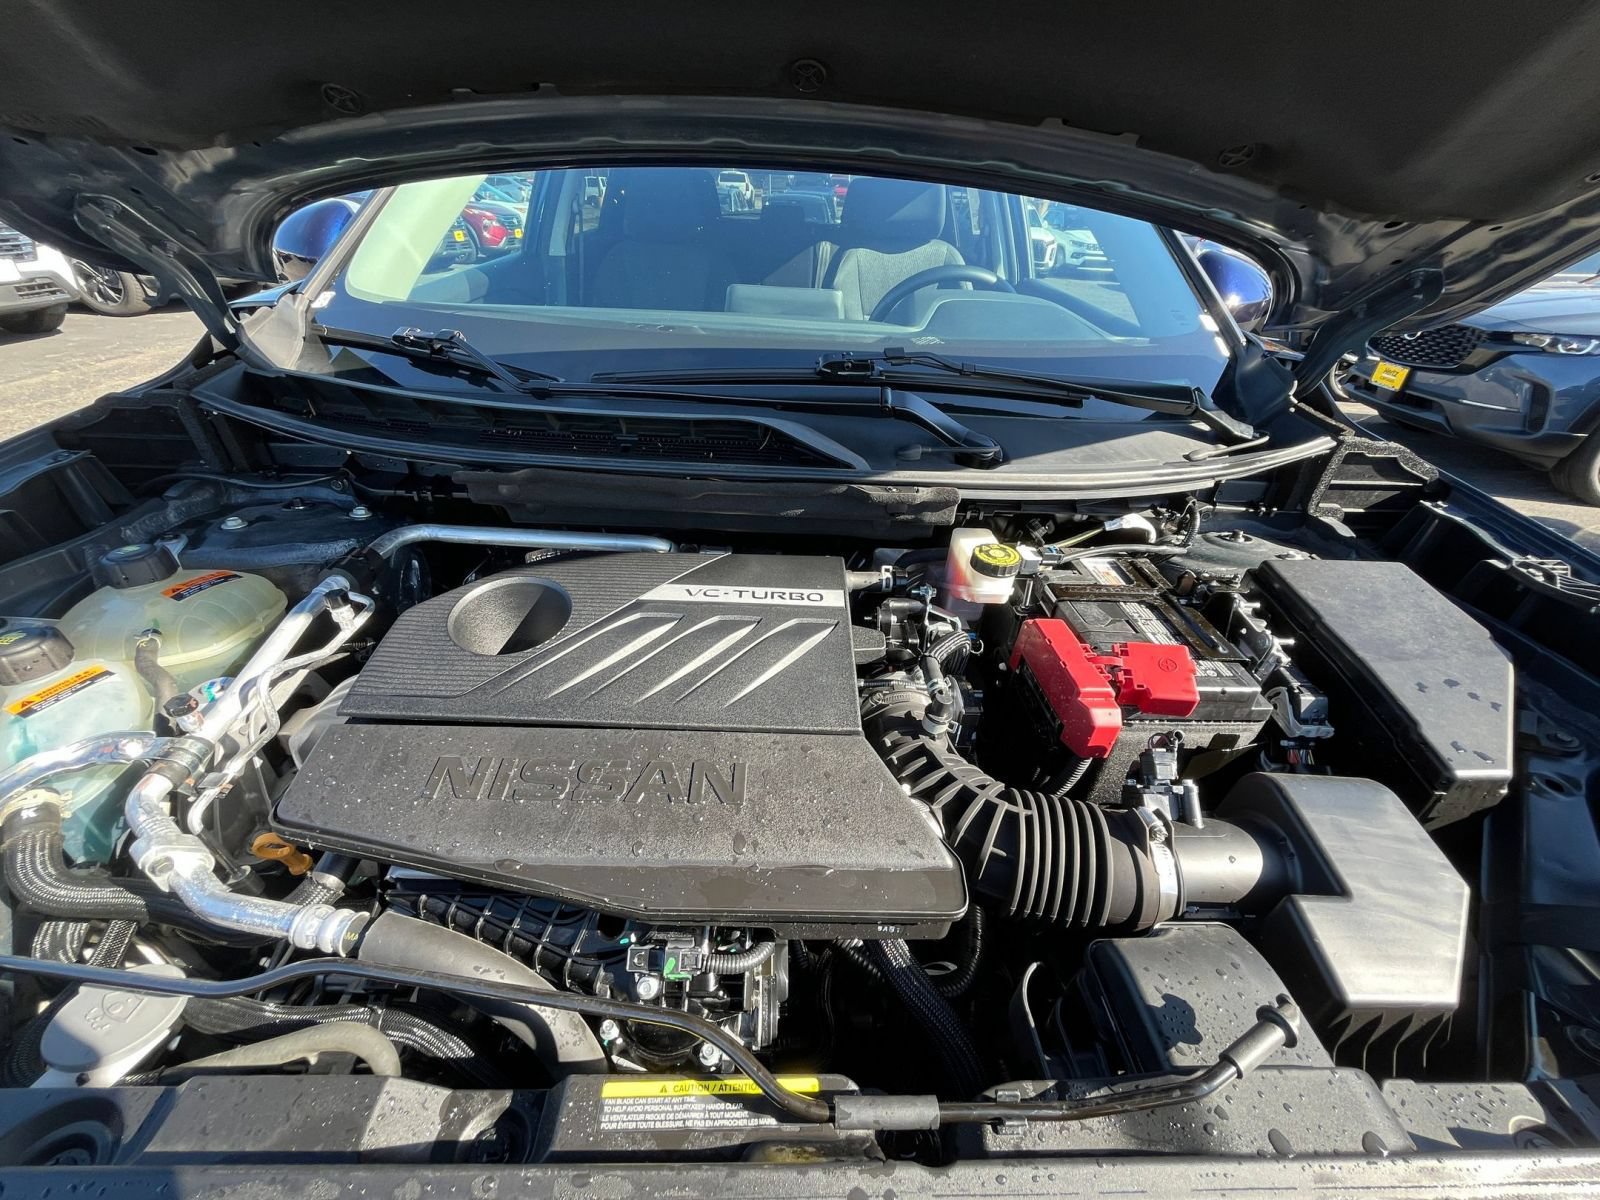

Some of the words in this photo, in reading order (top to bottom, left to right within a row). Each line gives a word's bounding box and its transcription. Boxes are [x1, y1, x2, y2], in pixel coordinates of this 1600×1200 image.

[421, 756, 750, 804] NISSAN
[719, 1083, 758, 1092] ATTENTIO
[616, 1097, 634, 1105] BLADE
[634, 1096, 647, 1104] CAN
[647, 1096, 663, 1104] START
[663, 1096, 671, 1104] AT
[612, 1105, 627, 1113] HELP
[644, 1104, 673, 1112] PERSONAL
[602, 1114, 610, 1122] LE
[610, 1113, 645, 1122] VENTILATEUR
[645, 1113, 666, 1121] RISQUE
[666, 1112, 675, 1120] DE
[710, 1111, 724, 1119] TOUT
[601, 1122, 617, 1130] POUR
[637, 1121, 655, 1129] TOUTE
[685, 1119, 693, 1127] NE
[693, 1119, 705, 1127] PAS
[705, 1119, 714, 1127] EN
[714, 1118, 748, 1127] APPROCHER
[748, 1118, 759, 1126] LES
